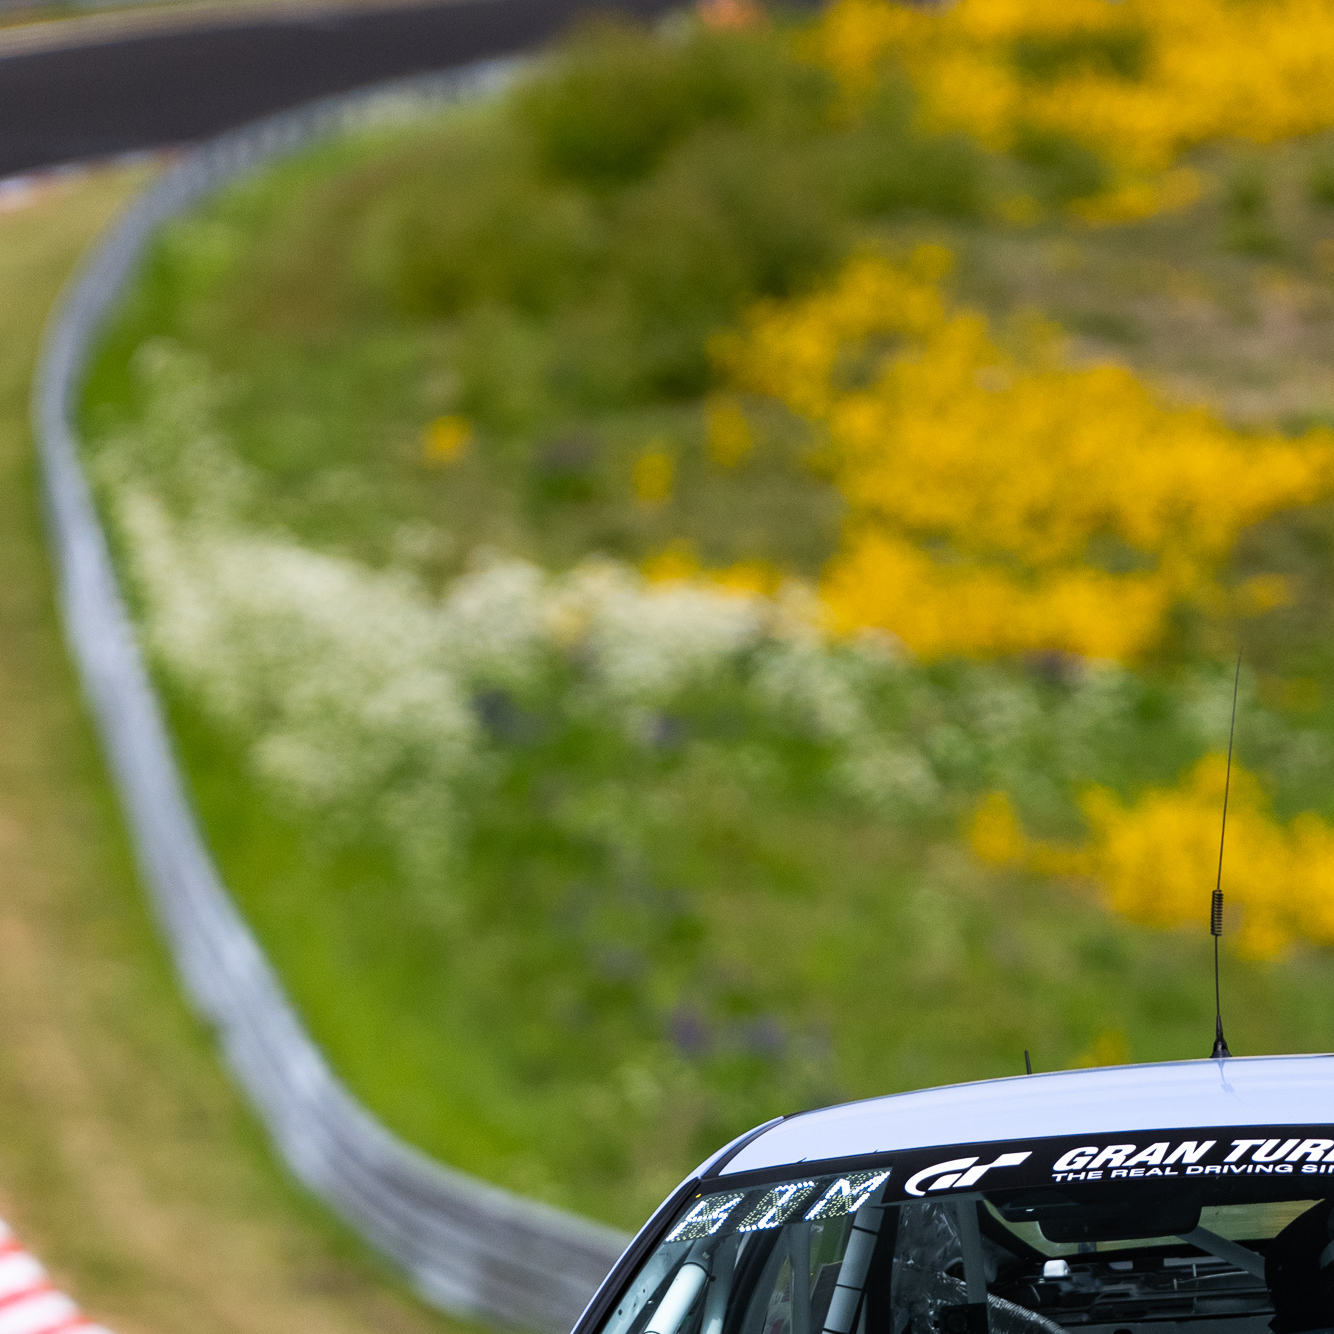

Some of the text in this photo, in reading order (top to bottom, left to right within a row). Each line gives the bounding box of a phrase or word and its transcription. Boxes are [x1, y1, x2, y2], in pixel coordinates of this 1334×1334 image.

[1052, 1140, 1218, 1172] GRAN
[1051, 1171, 1104, 1182] THE
[1110, 1167, 1179, 1179] REAL
[1185, 1164, 1293, 1176] DRIVING
